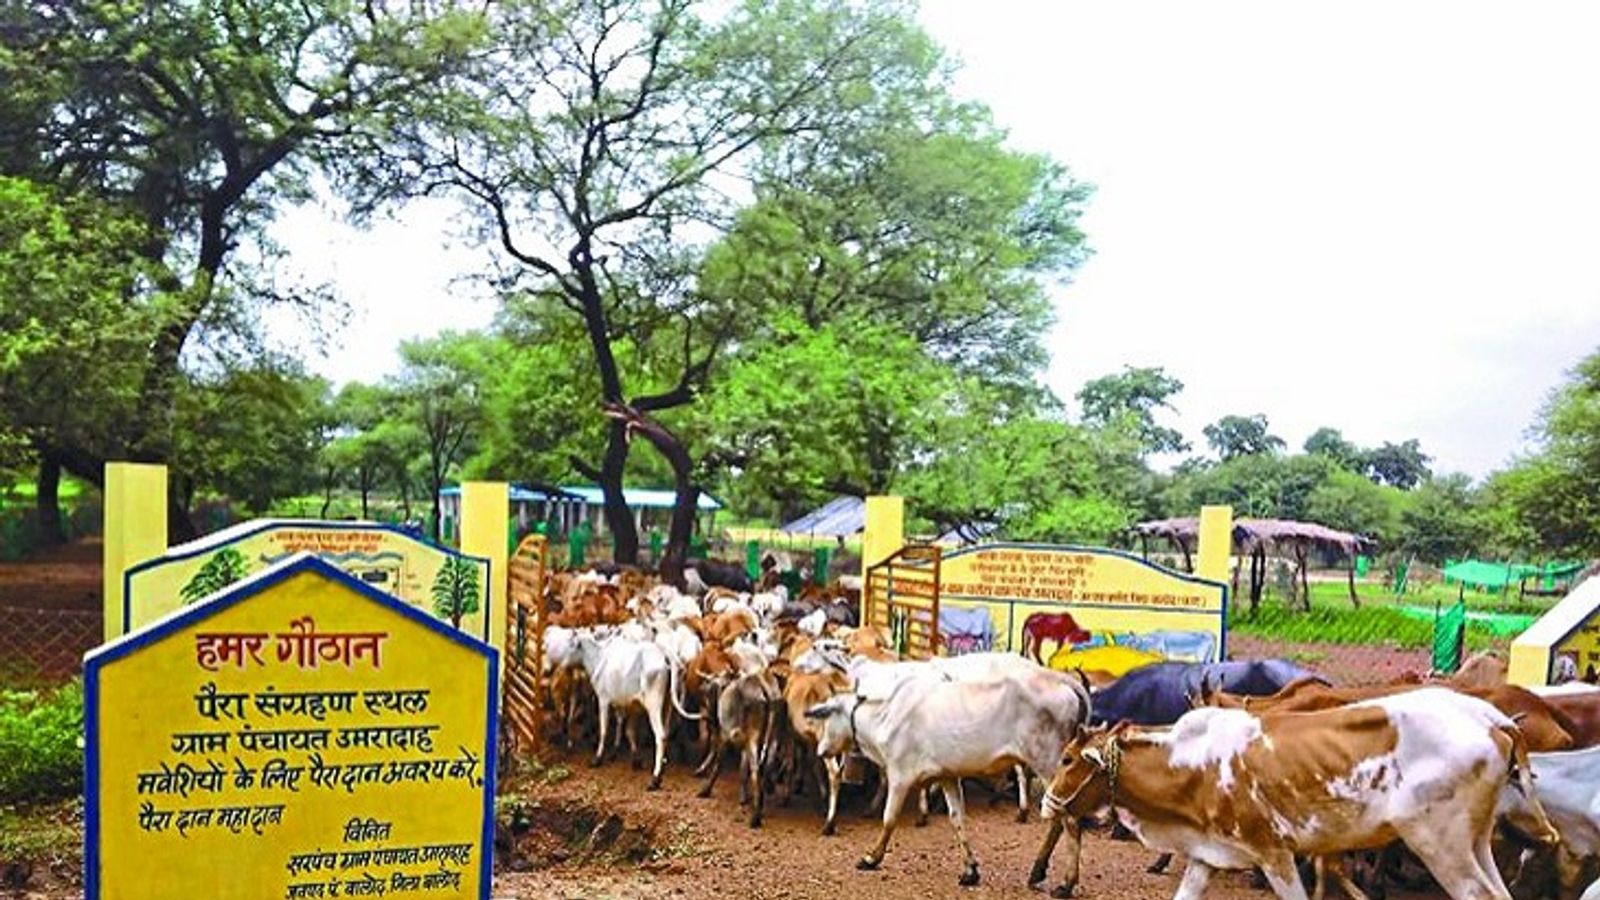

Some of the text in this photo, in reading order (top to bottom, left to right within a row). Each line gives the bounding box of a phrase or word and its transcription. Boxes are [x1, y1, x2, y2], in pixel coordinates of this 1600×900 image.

[195, 616, 388, 672] हमर गौठान
[194, 682, 430, 721] पैरा संग्रहण स्थल
[171, 724, 440, 755] ग्राम पंचायत उमरादाह
[137, 759, 228, 802] मवेशियों
[233, 756, 257, 789] के
[261, 763, 305, 792] लिए
[308, 753, 342, 790] पैरा
[342, 763, 382, 793] दान
[383, 760, 450, 784] अवश्य
[139, 801, 173, 832] पैरा
[176, 809, 213, 838] दान
